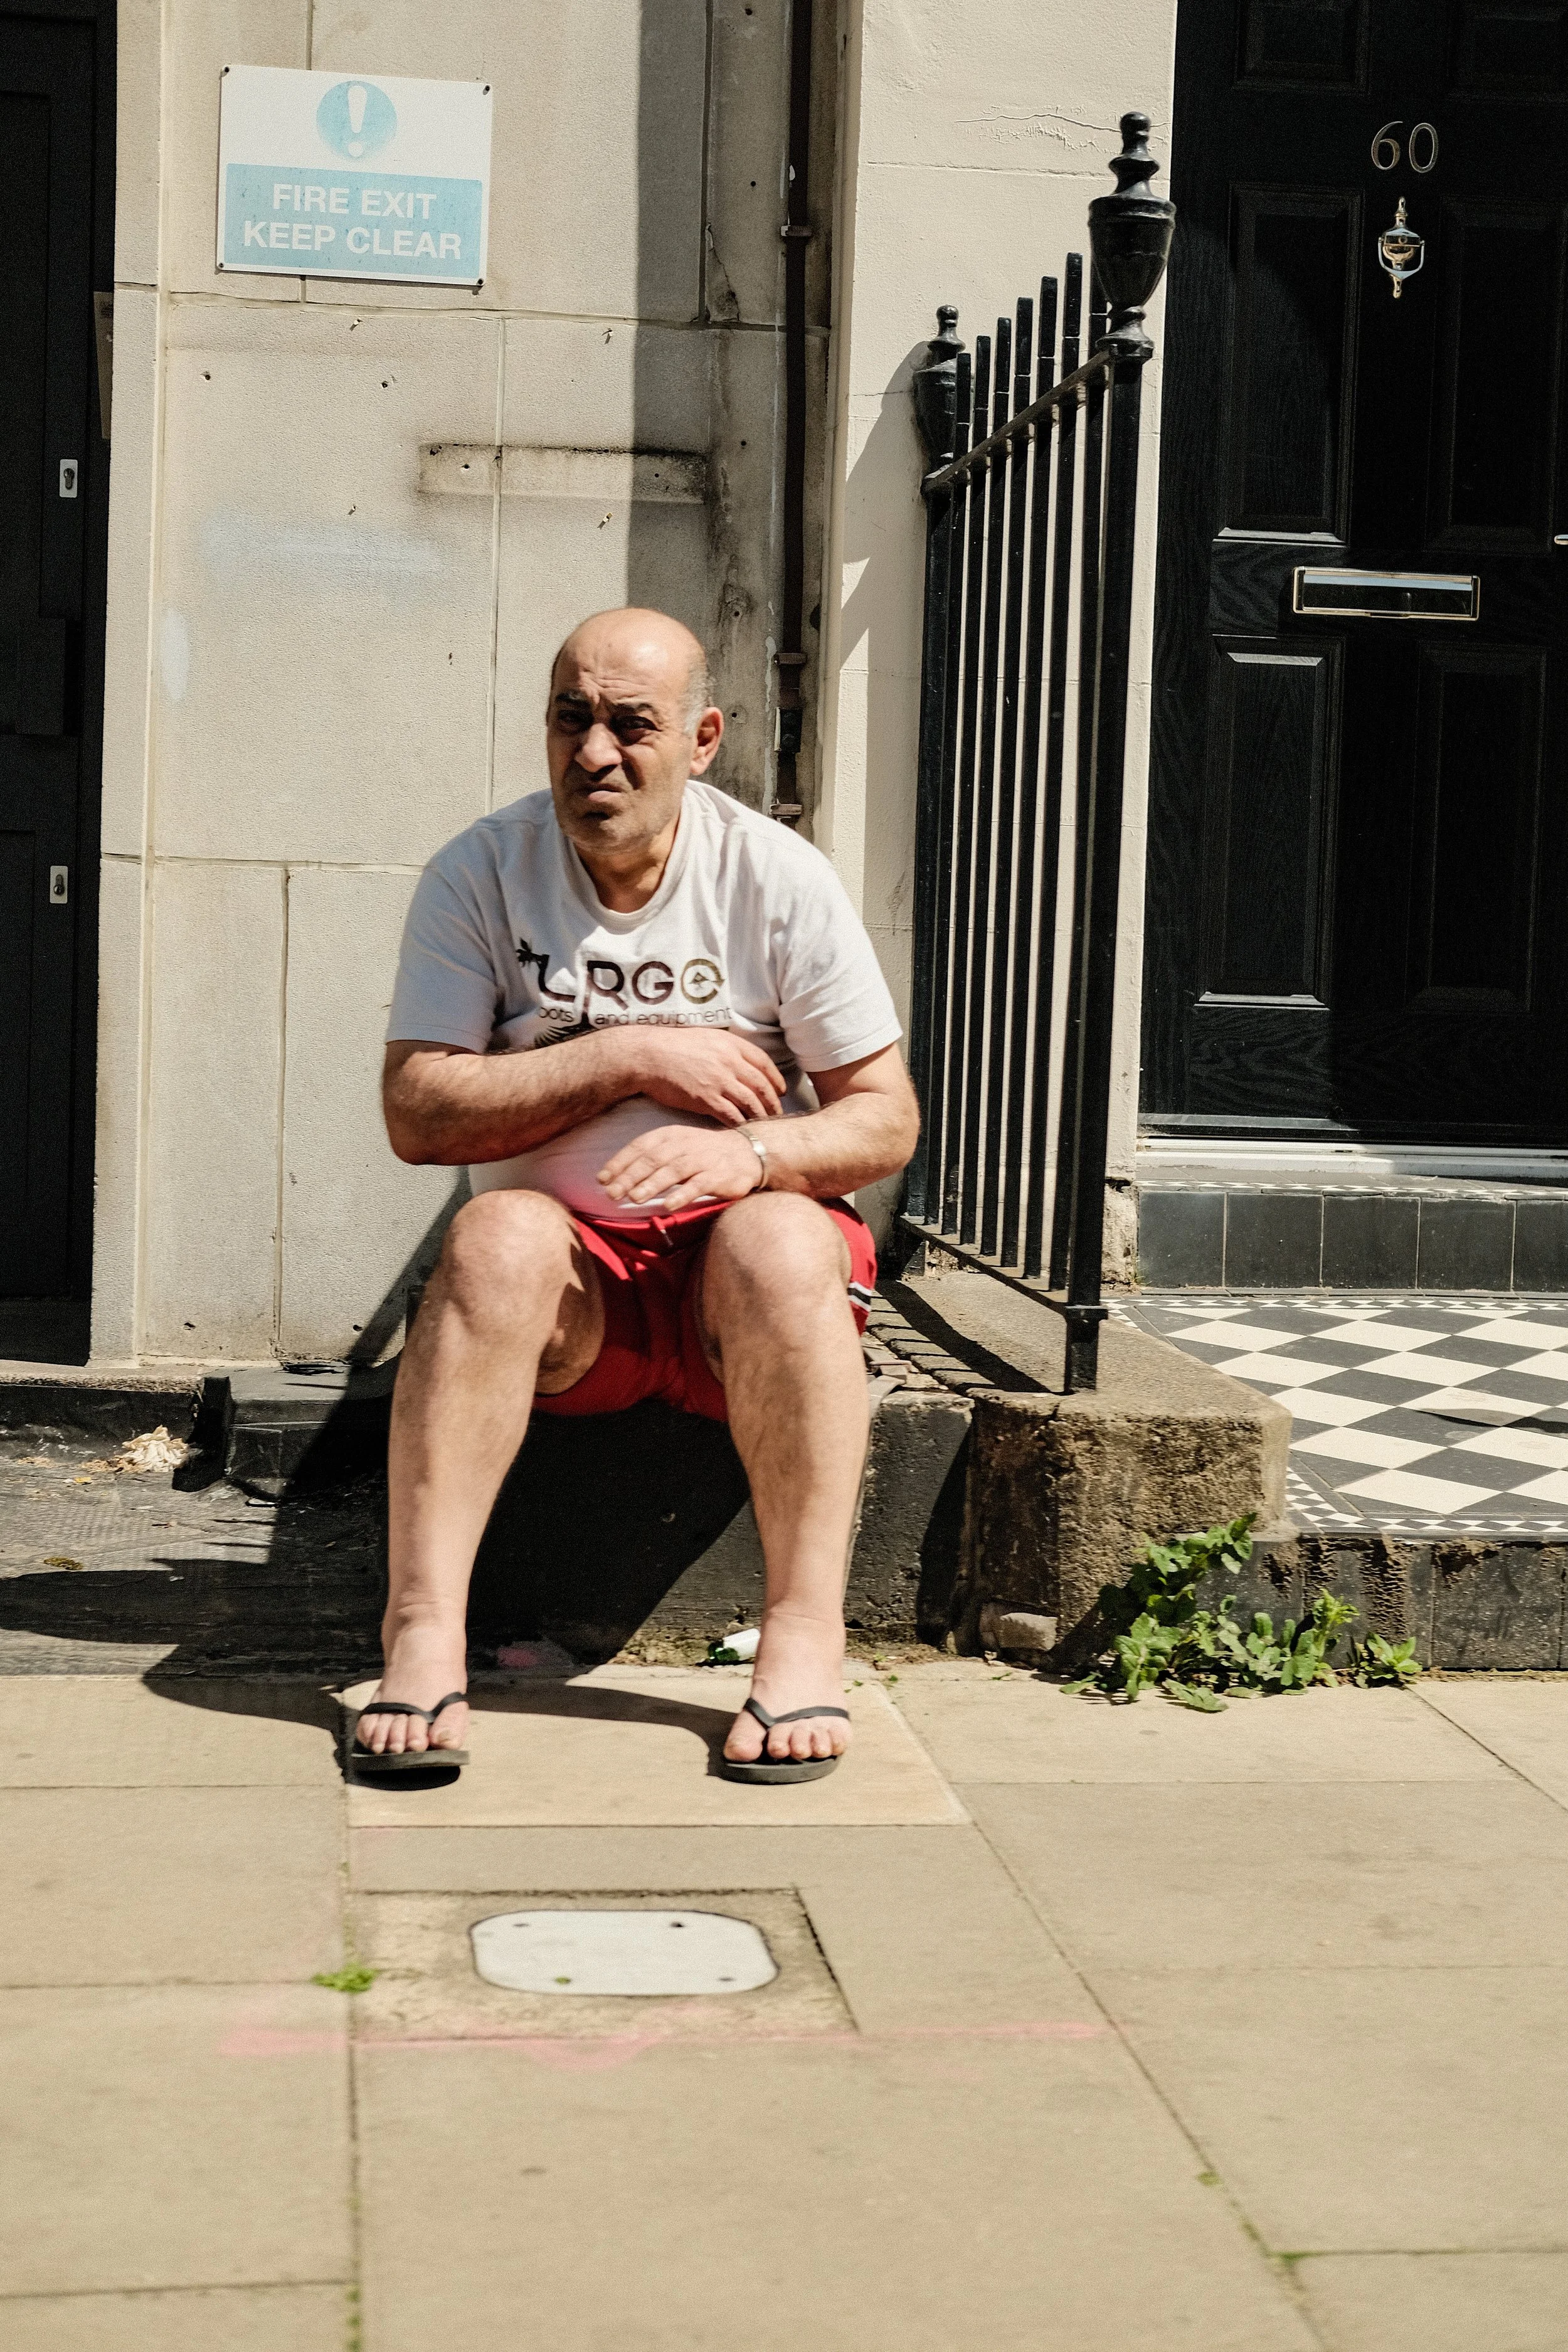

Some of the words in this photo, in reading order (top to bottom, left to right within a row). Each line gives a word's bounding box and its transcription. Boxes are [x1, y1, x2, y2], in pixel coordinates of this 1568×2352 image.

[1371, 120, 1439, 173] 60
[273, 183, 350, 215] FIRE
[361, 189, 437, 220] EXIT
[243, 220, 336, 251] KEEP
[346, 227, 461, 260] CLEAR
[539, 1007, 575, 1023] oots
